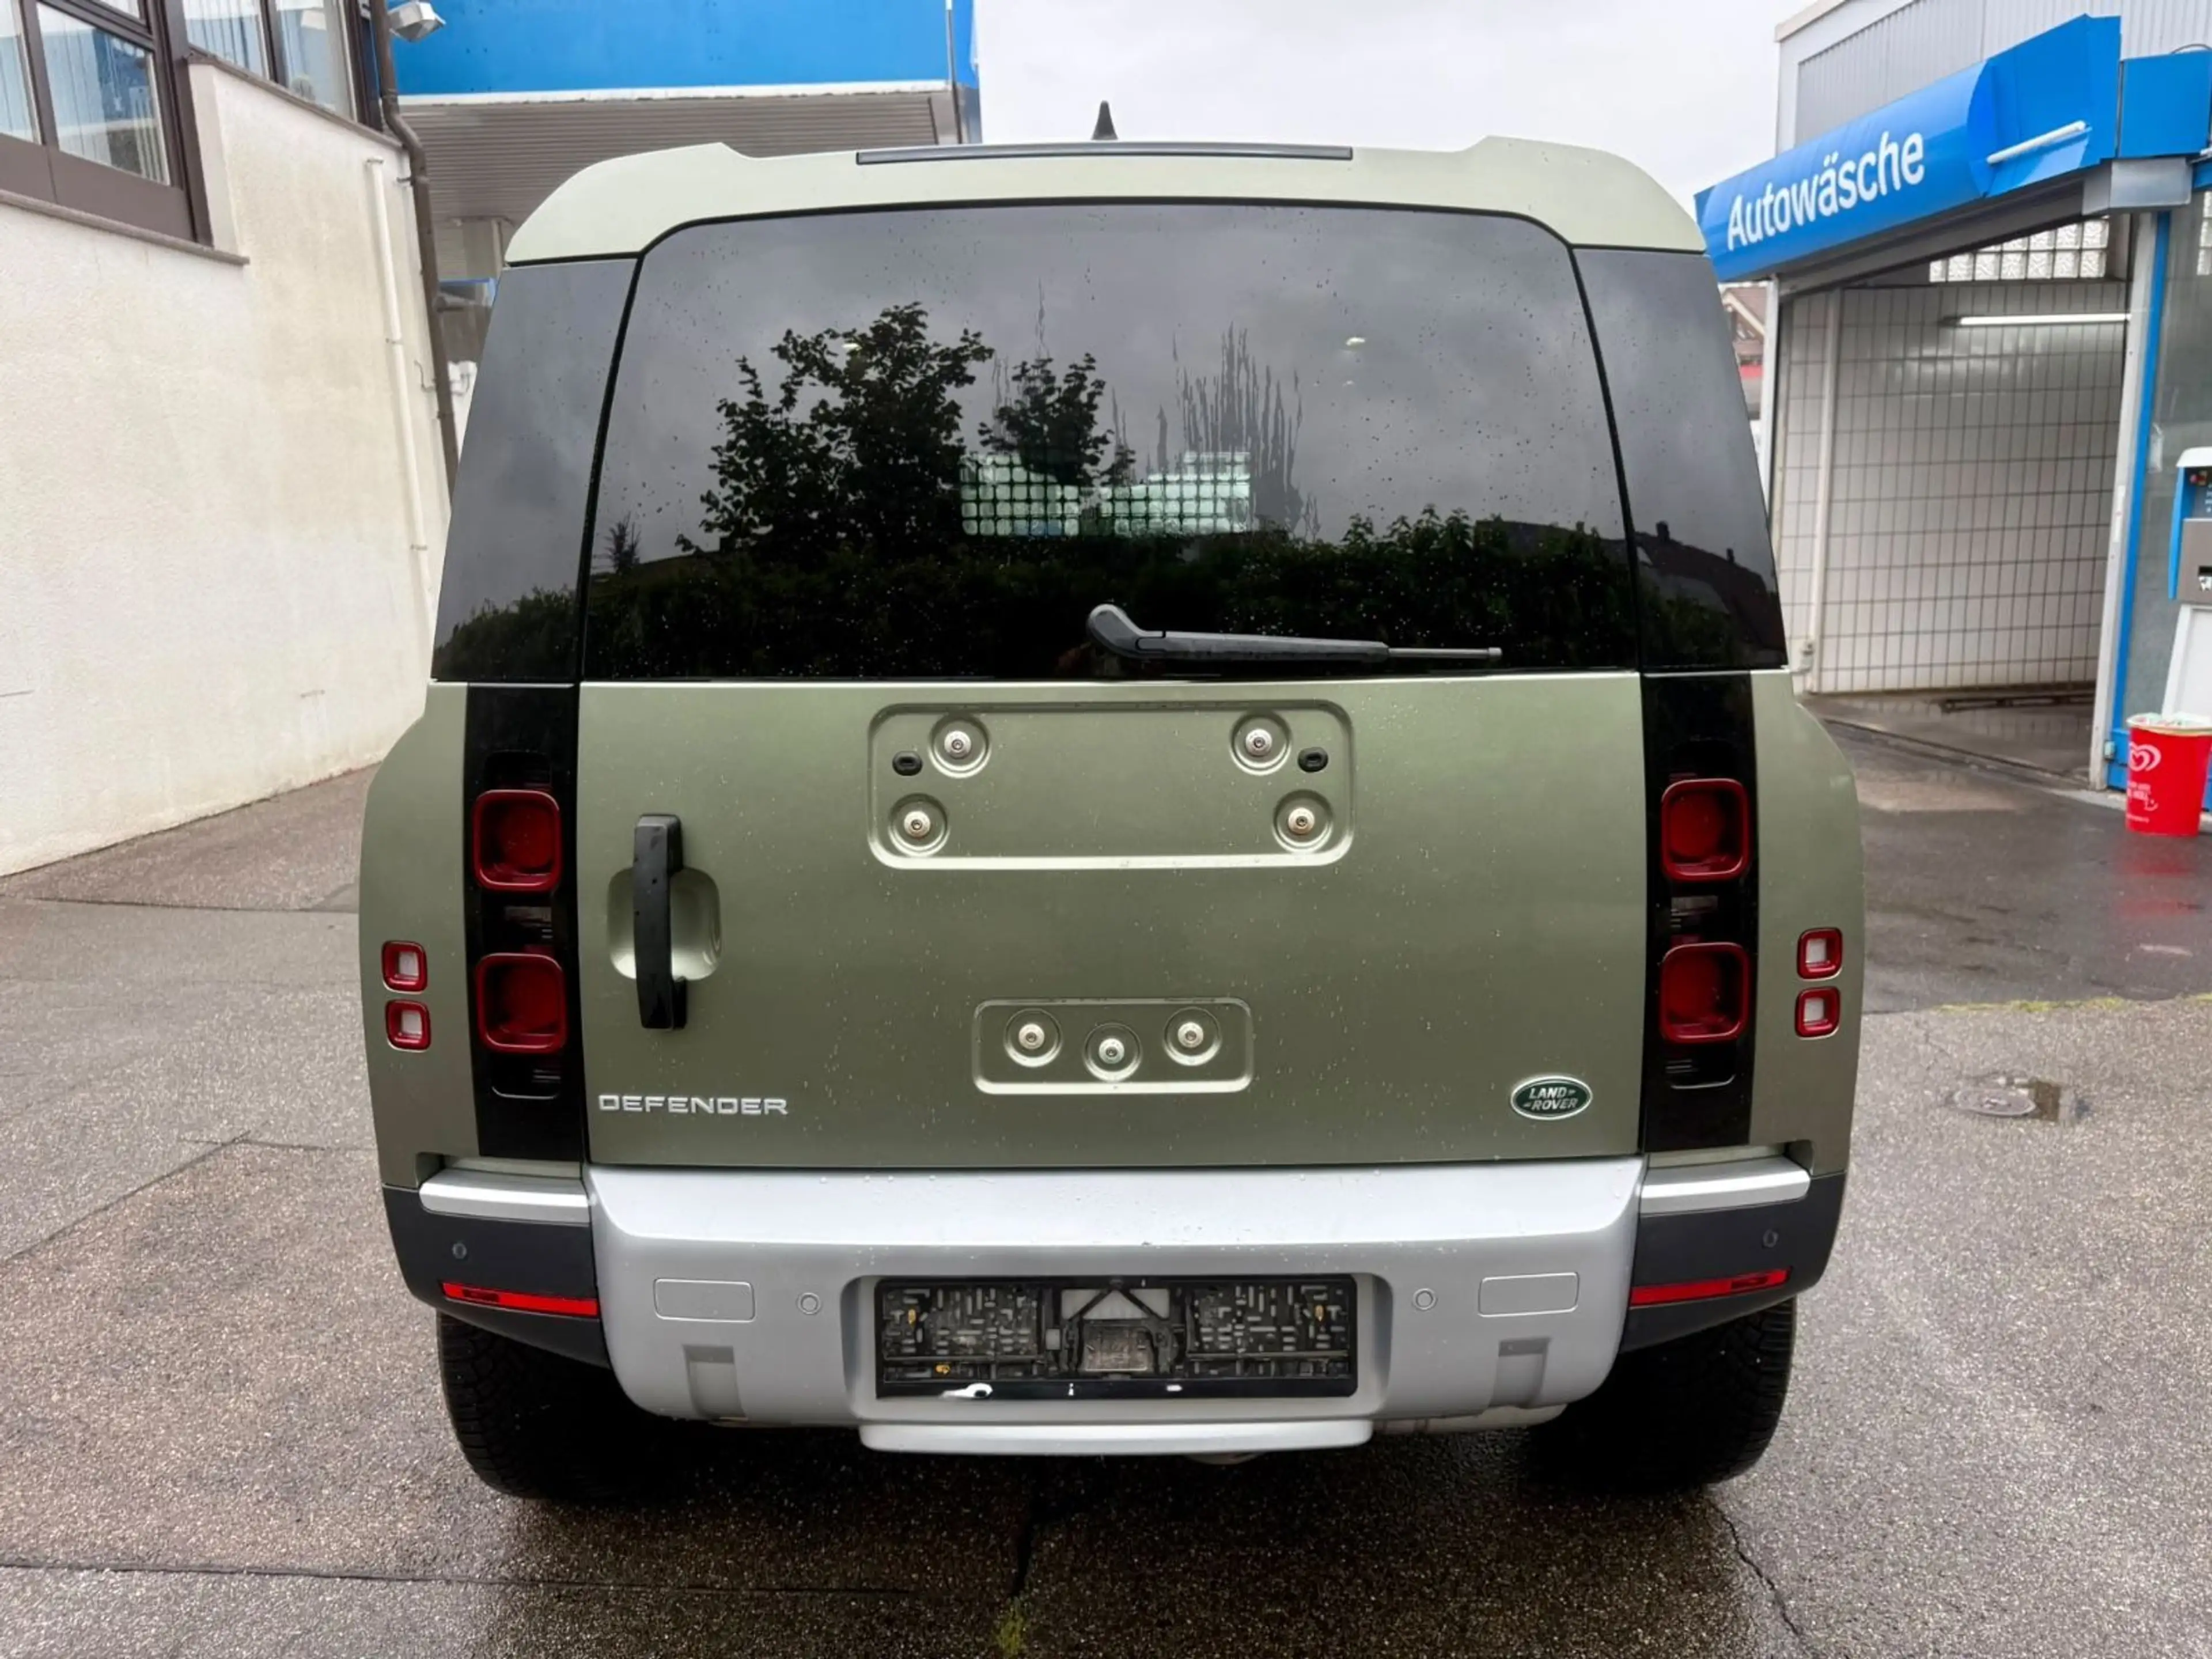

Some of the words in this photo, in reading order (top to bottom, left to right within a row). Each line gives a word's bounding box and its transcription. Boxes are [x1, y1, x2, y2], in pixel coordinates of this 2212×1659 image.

[1728, 131, 1925, 251] Autowäsche
[1529, 1086, 1567, 1099] LAND
[599, 1094, 789, 1115] DEFENDER
[1531, 1097, 1578, 1111] ROVER
